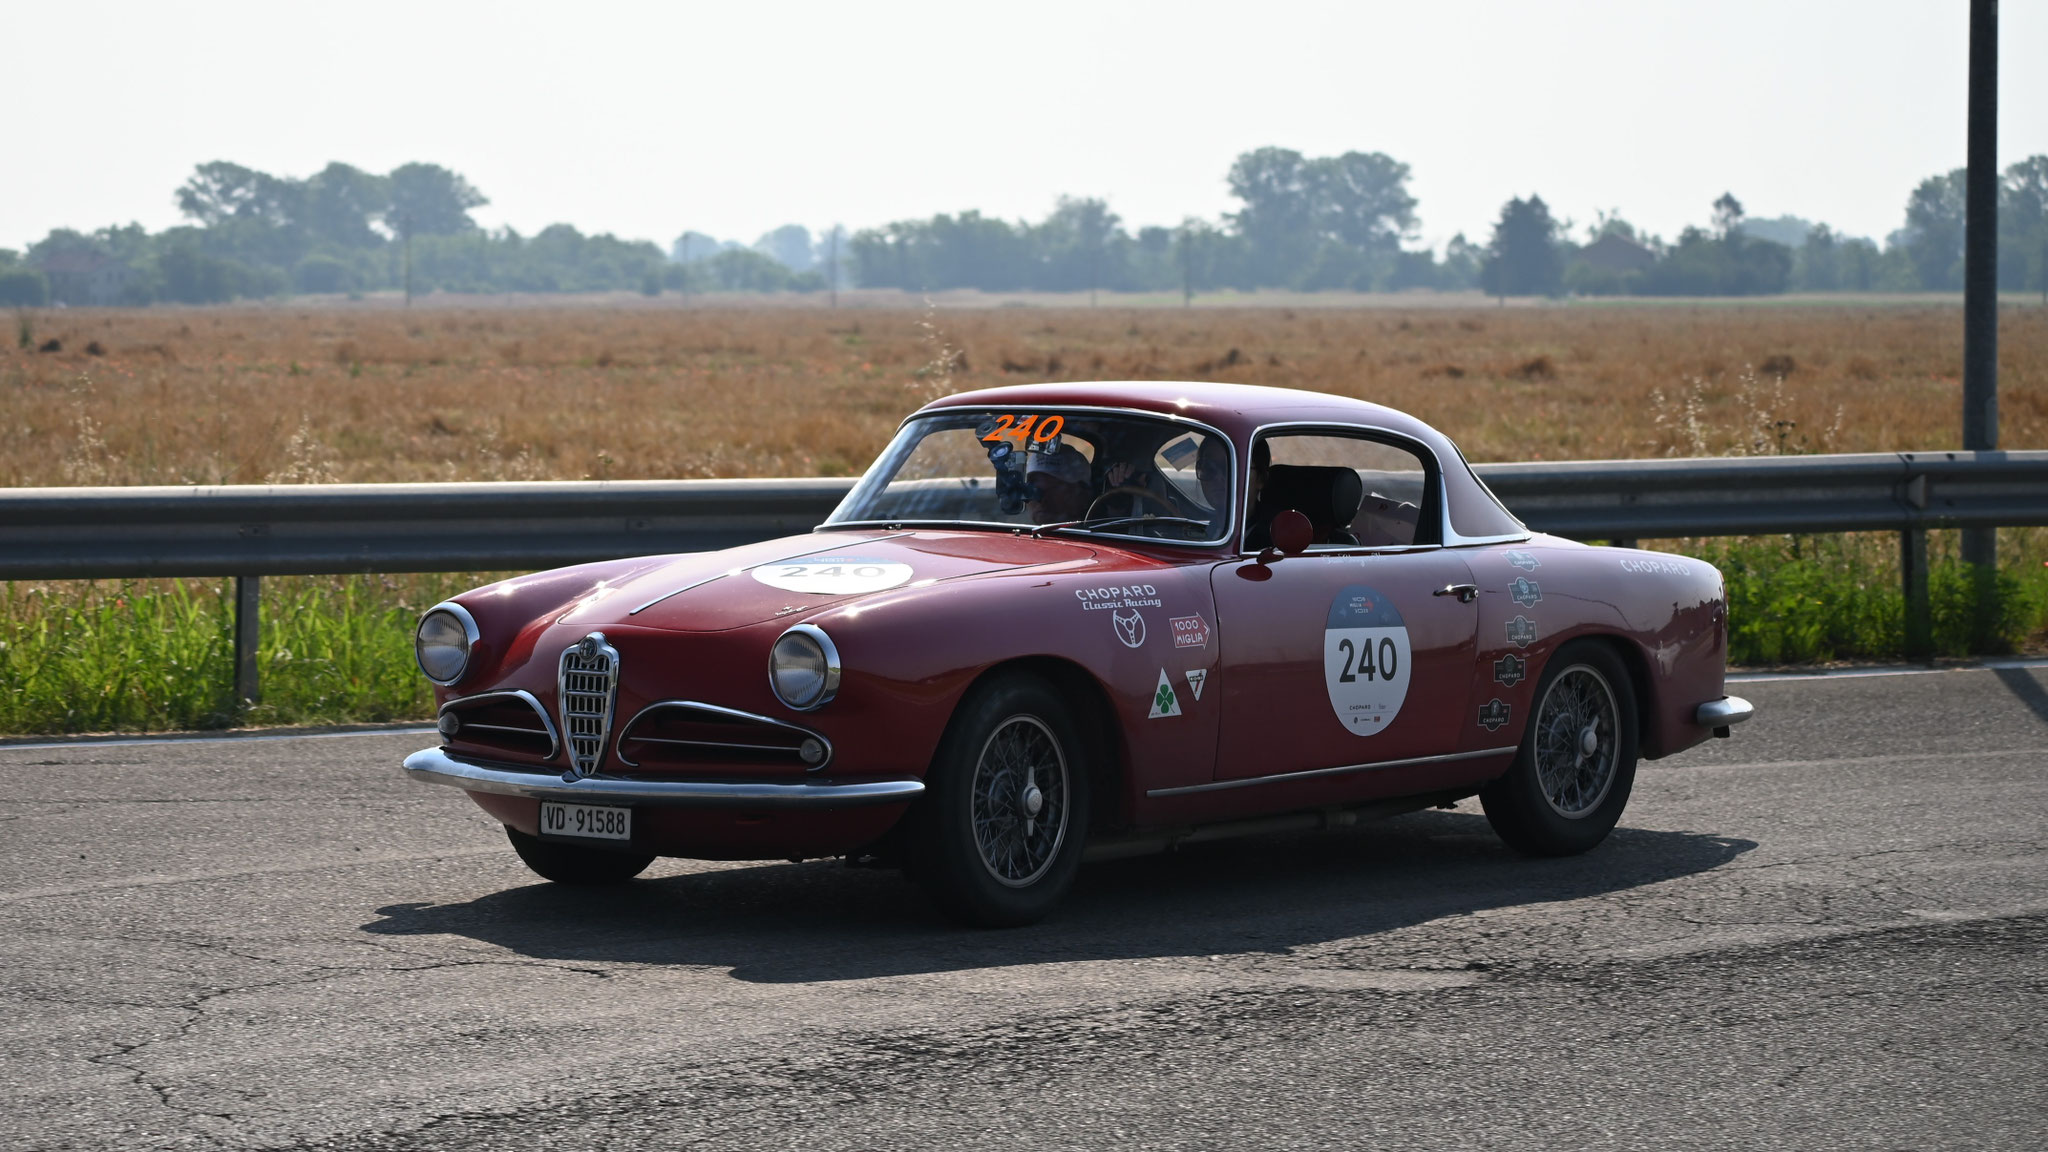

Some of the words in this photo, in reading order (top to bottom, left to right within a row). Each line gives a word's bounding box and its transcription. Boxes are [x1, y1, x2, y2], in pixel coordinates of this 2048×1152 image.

[982, 414, 1064, 442] 240
[779, 566, 887, 578] 240
[1619, 559, 1691, 576] CHOPARD
[1075, 584, 1157, 601] CHOPARD
[1082, 600, 1124, 611] Classic
[1123, 597, 1162, 608] Racing
[1175, 619, 1199, 631] 1000
[1176, 632, 1204, 645] MIGLIA
[1338, 637, 1397, 683] 240
